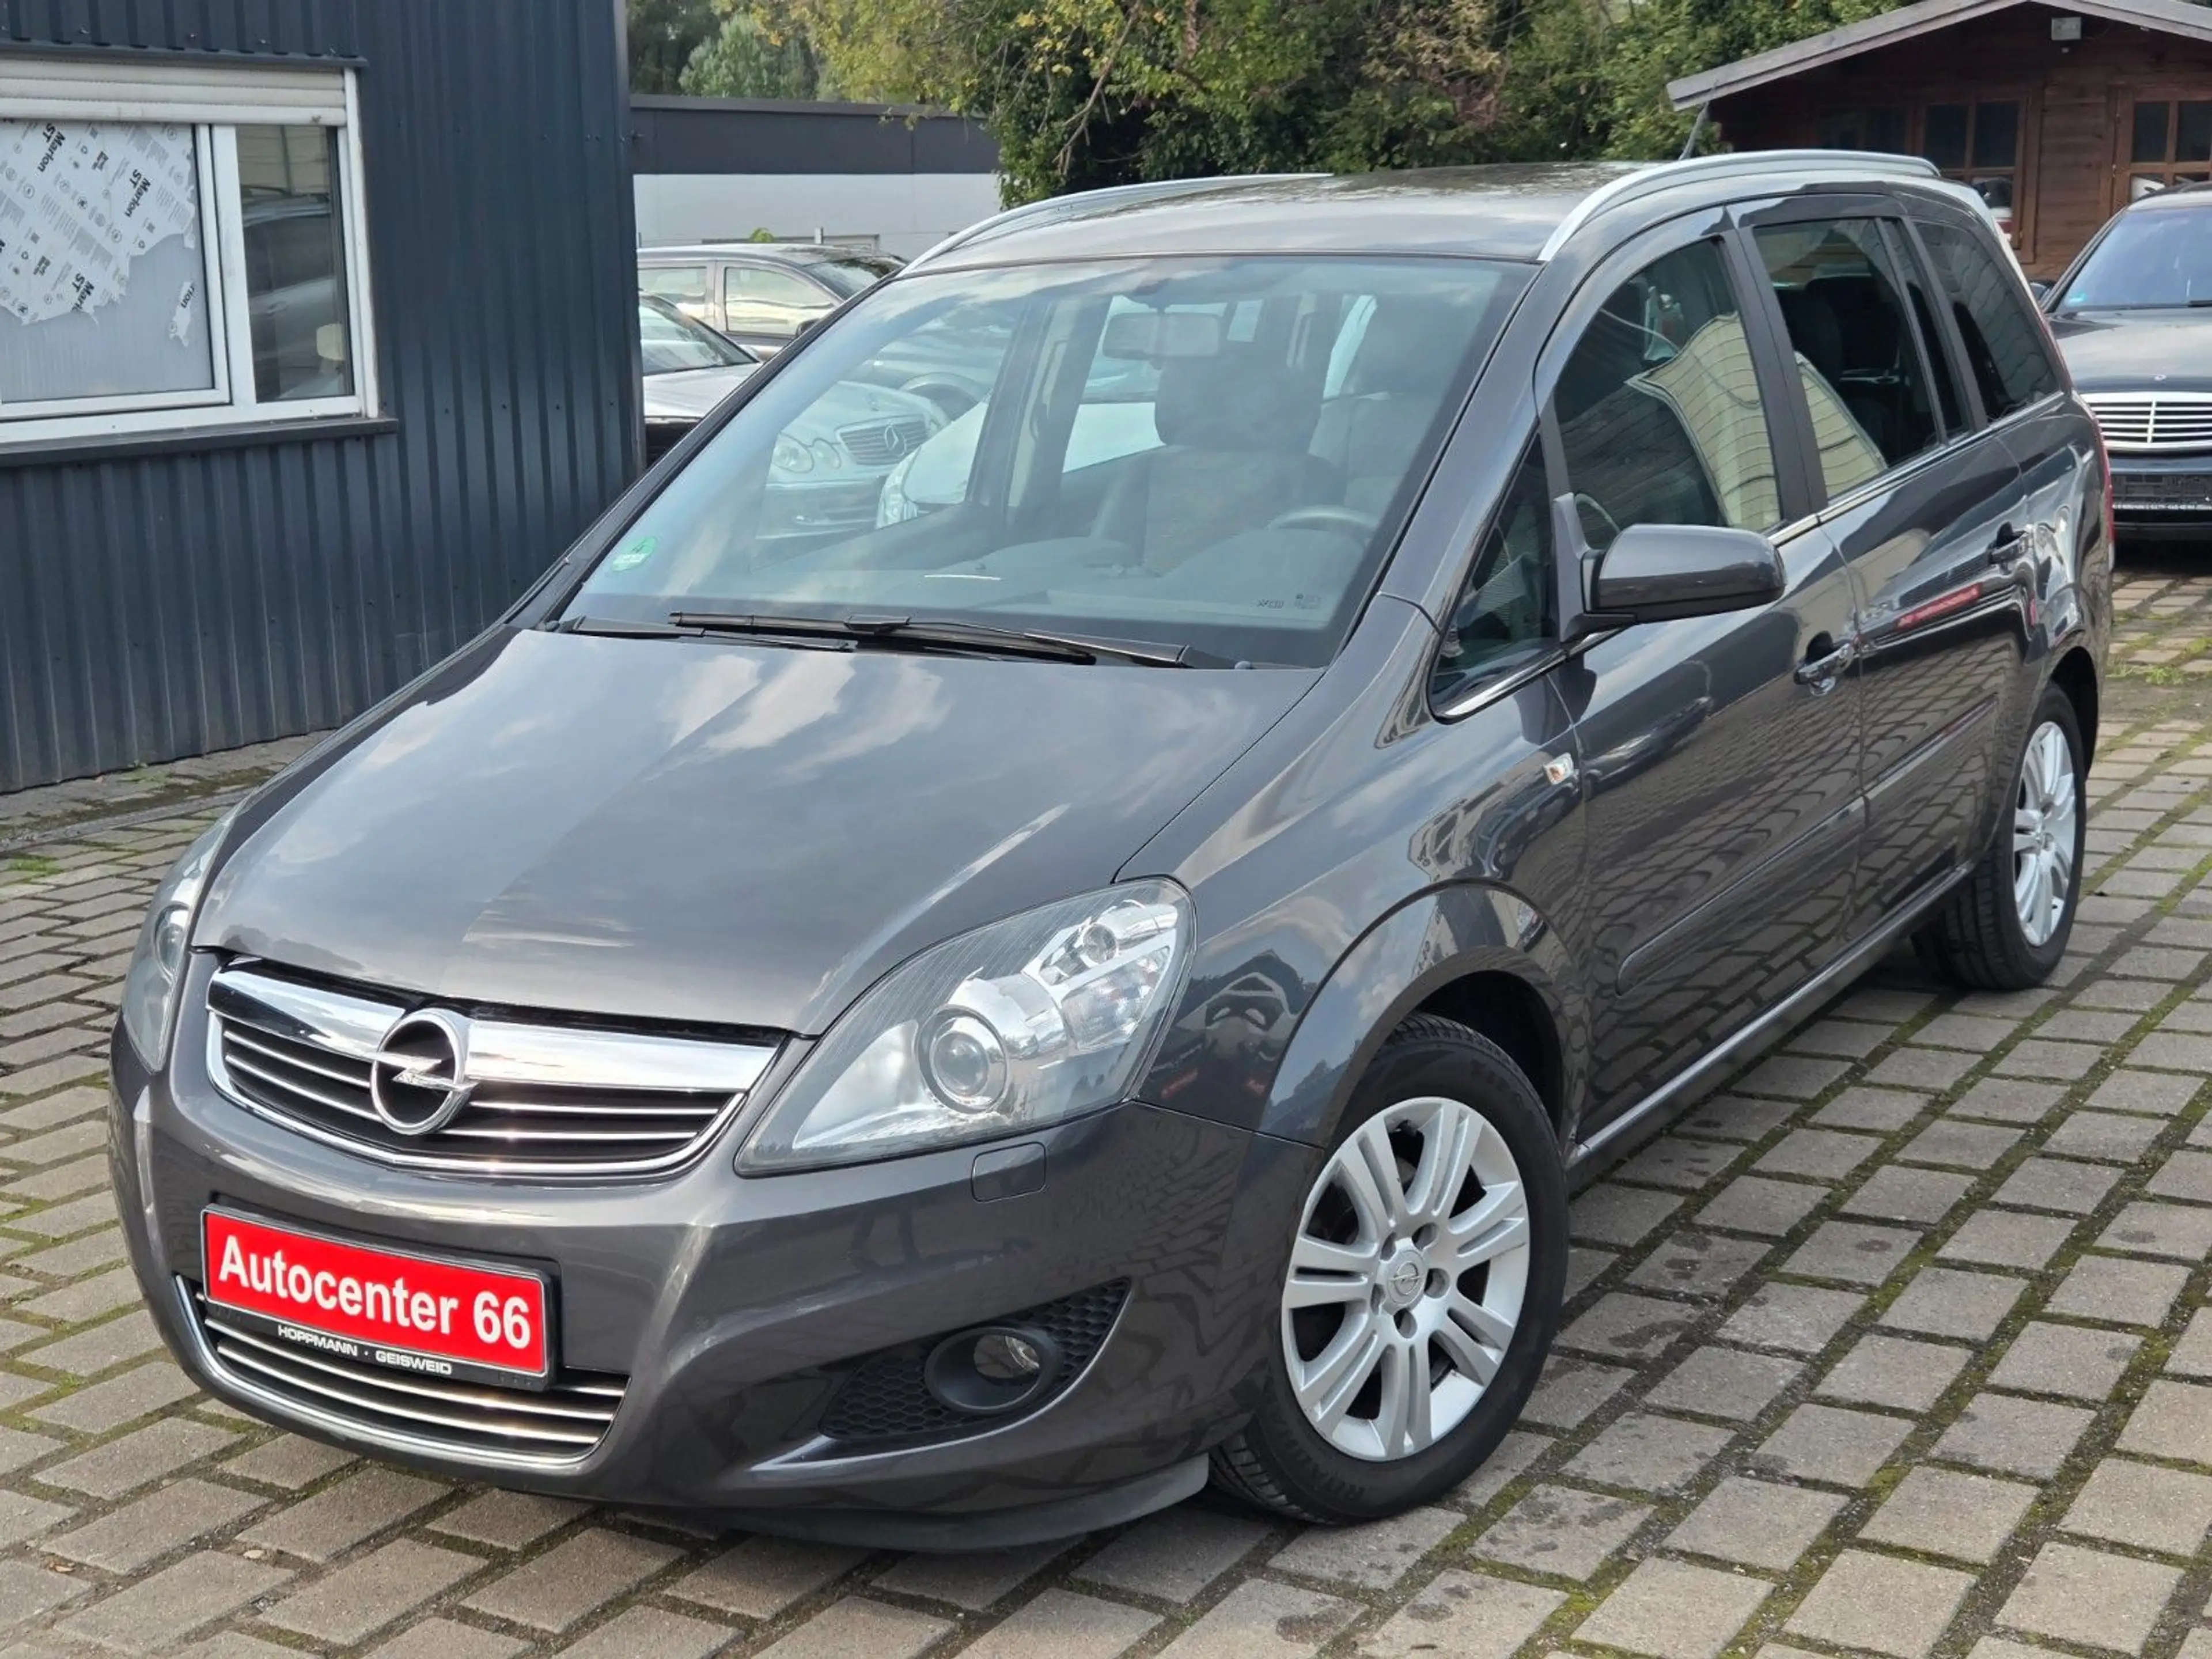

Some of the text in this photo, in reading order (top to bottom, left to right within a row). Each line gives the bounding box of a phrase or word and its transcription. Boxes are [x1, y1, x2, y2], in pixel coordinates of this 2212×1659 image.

[37, 131, 65, 172] Marlon
[43, 123, 56, 143] ST
[124, 177, 151, 218] Marlon
[129, 169, 142, 190] ST
[72, 273, 85, 293] ST
[218, 1234, 531, 1350] Autocenter 66
[278, 1325, 453, 1376] HOPPMANN GEISWEID
